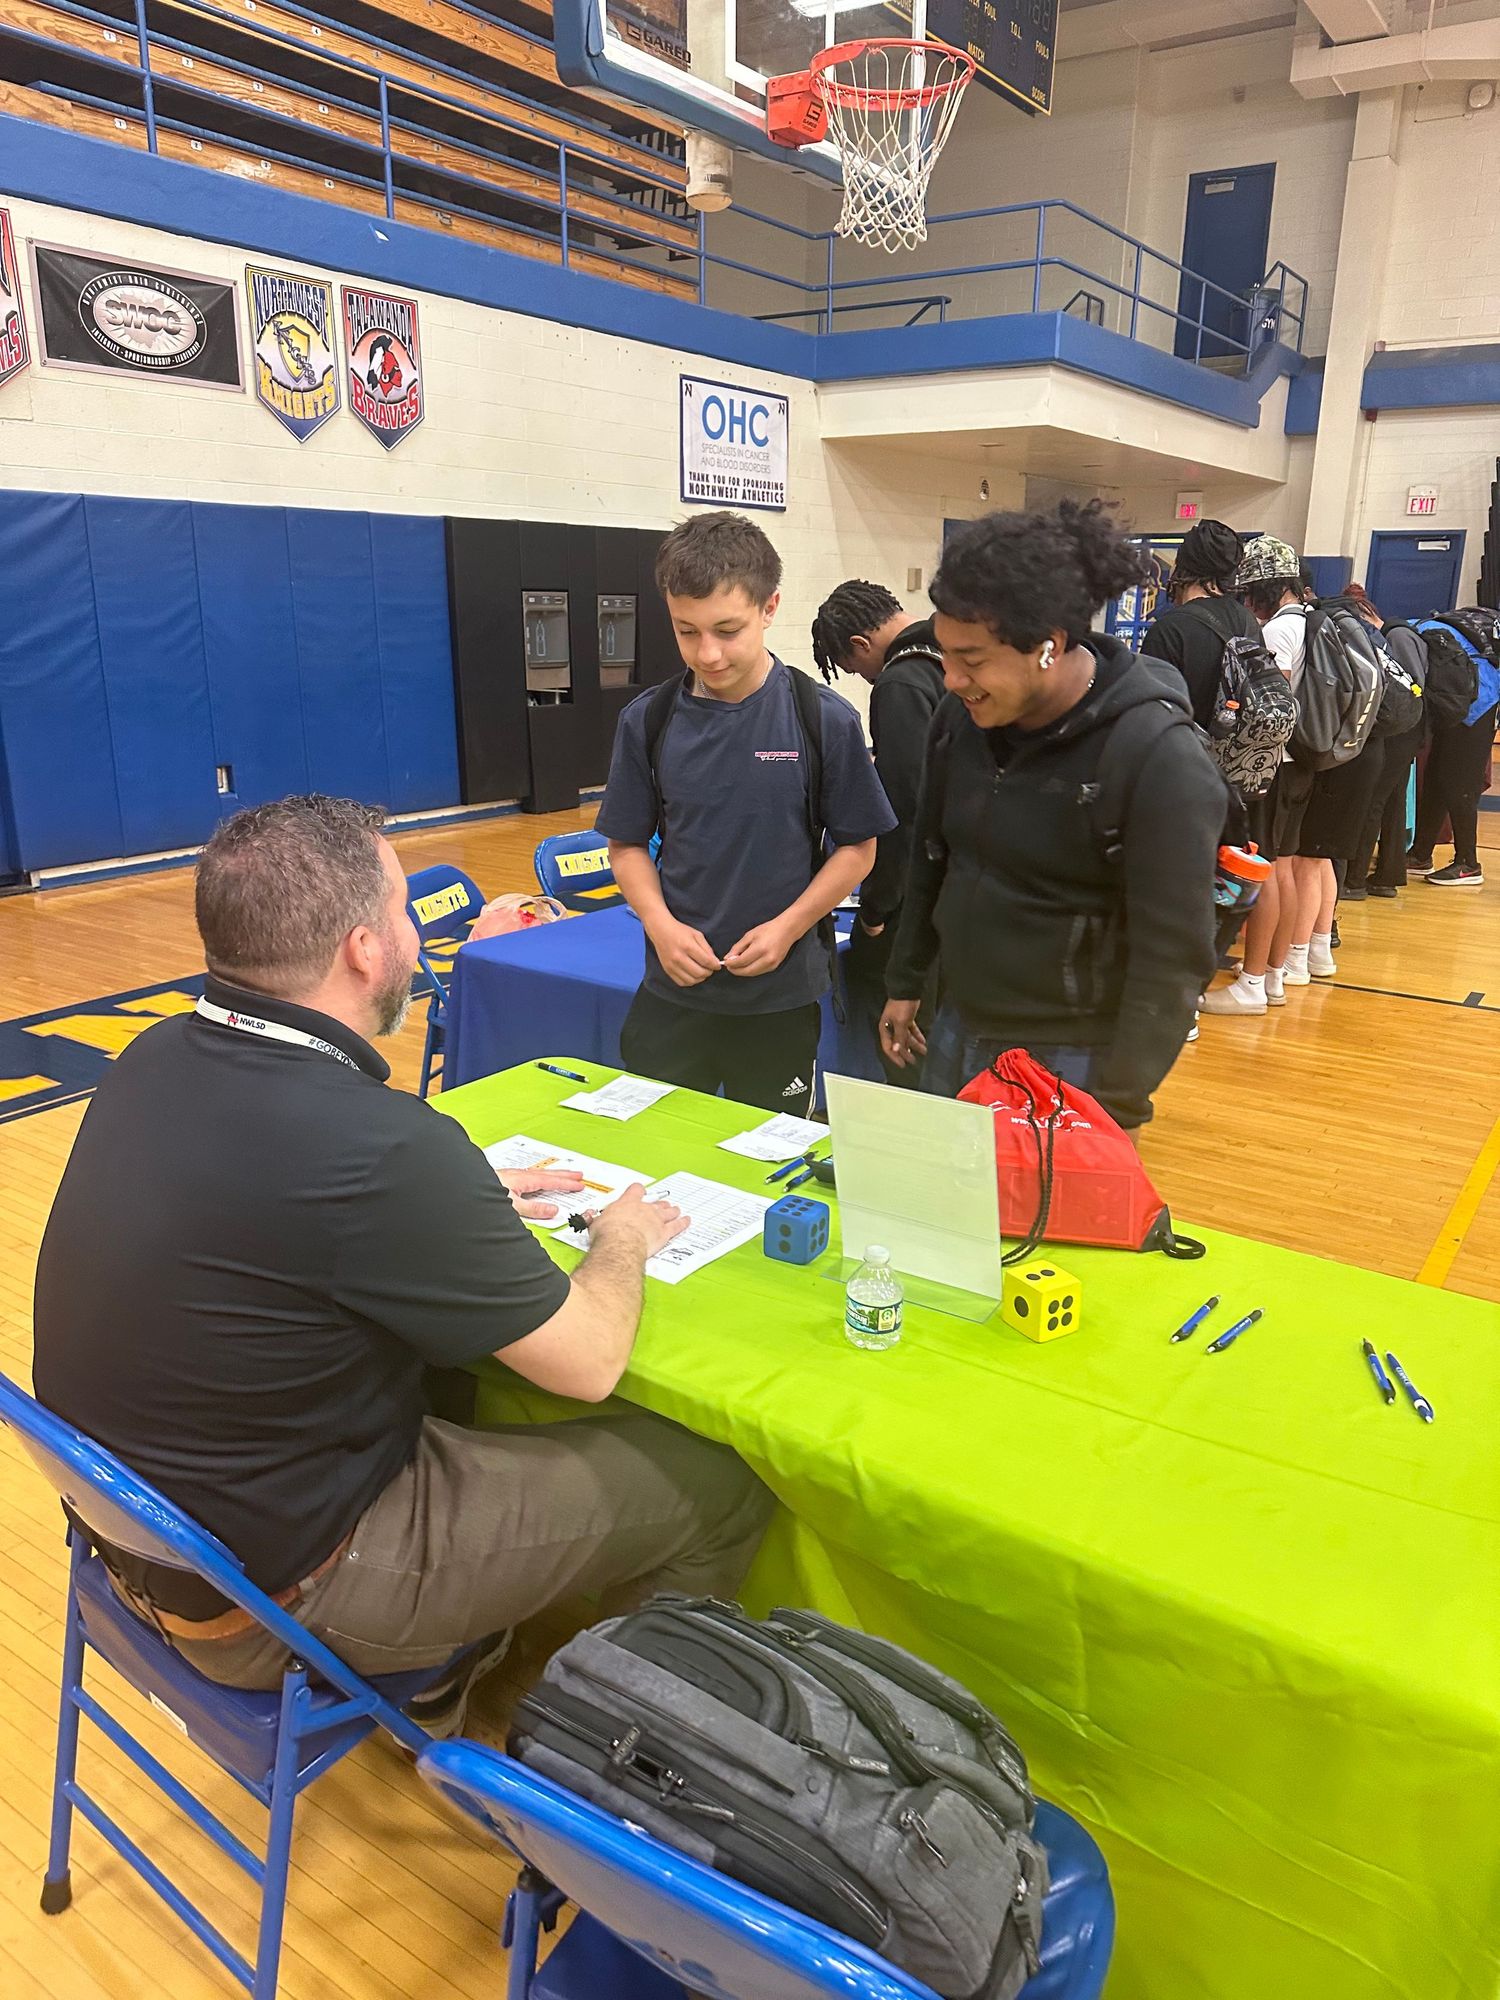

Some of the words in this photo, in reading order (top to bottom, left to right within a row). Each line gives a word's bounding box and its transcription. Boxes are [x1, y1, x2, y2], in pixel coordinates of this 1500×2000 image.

[644, 31, 691, 63] GARED
[967, 42, 985, 63] MATCH
[1035, 40, 1049, 60] FOULS
[1031, 86, 1046, 105] SCORE
[128, 275, 149, 287] OHIO
[155, 281, 203, 325] CONFERENCE
[252, 273, 330, 350] NORTHWEST
[105, 299, 181, 336] SWOC
[347, 292, 416, 358] TALAWANDA
[91, 327, 120, 354] INTEGRITY
[258, 359, 336, 420] KNIGHTS
[352, 374, 419, 429] BRAVES
[702, 394, 769, 447] OHC
[702, 443, 736, 457] SPECIALISTS
[737, 449, 744, 457] IN
[745, 450, 769, 461] CANCER
[701, 457, 715, 467] AND
[717, 458, 738, 470] BLOOD
[740, 461, 770, 474] DISORDERS
[689, 471, 709, 483] THANK
[713, 474, 725, 484] YOU
[729, 477, 740, 487] FOR
[743, 478, 783, 491] SPONSORING
[689, 482, 737, 499] NORTHWEST
[742, 489, 784, 503] ATHLETICS
[1410, 497, 1436, 512] EXIT
[411, 882, 470, 926] KNIGHTS
[239, 1017, 266, 1030] NWLSD
[782, 1085, 808, 1096] adidas
